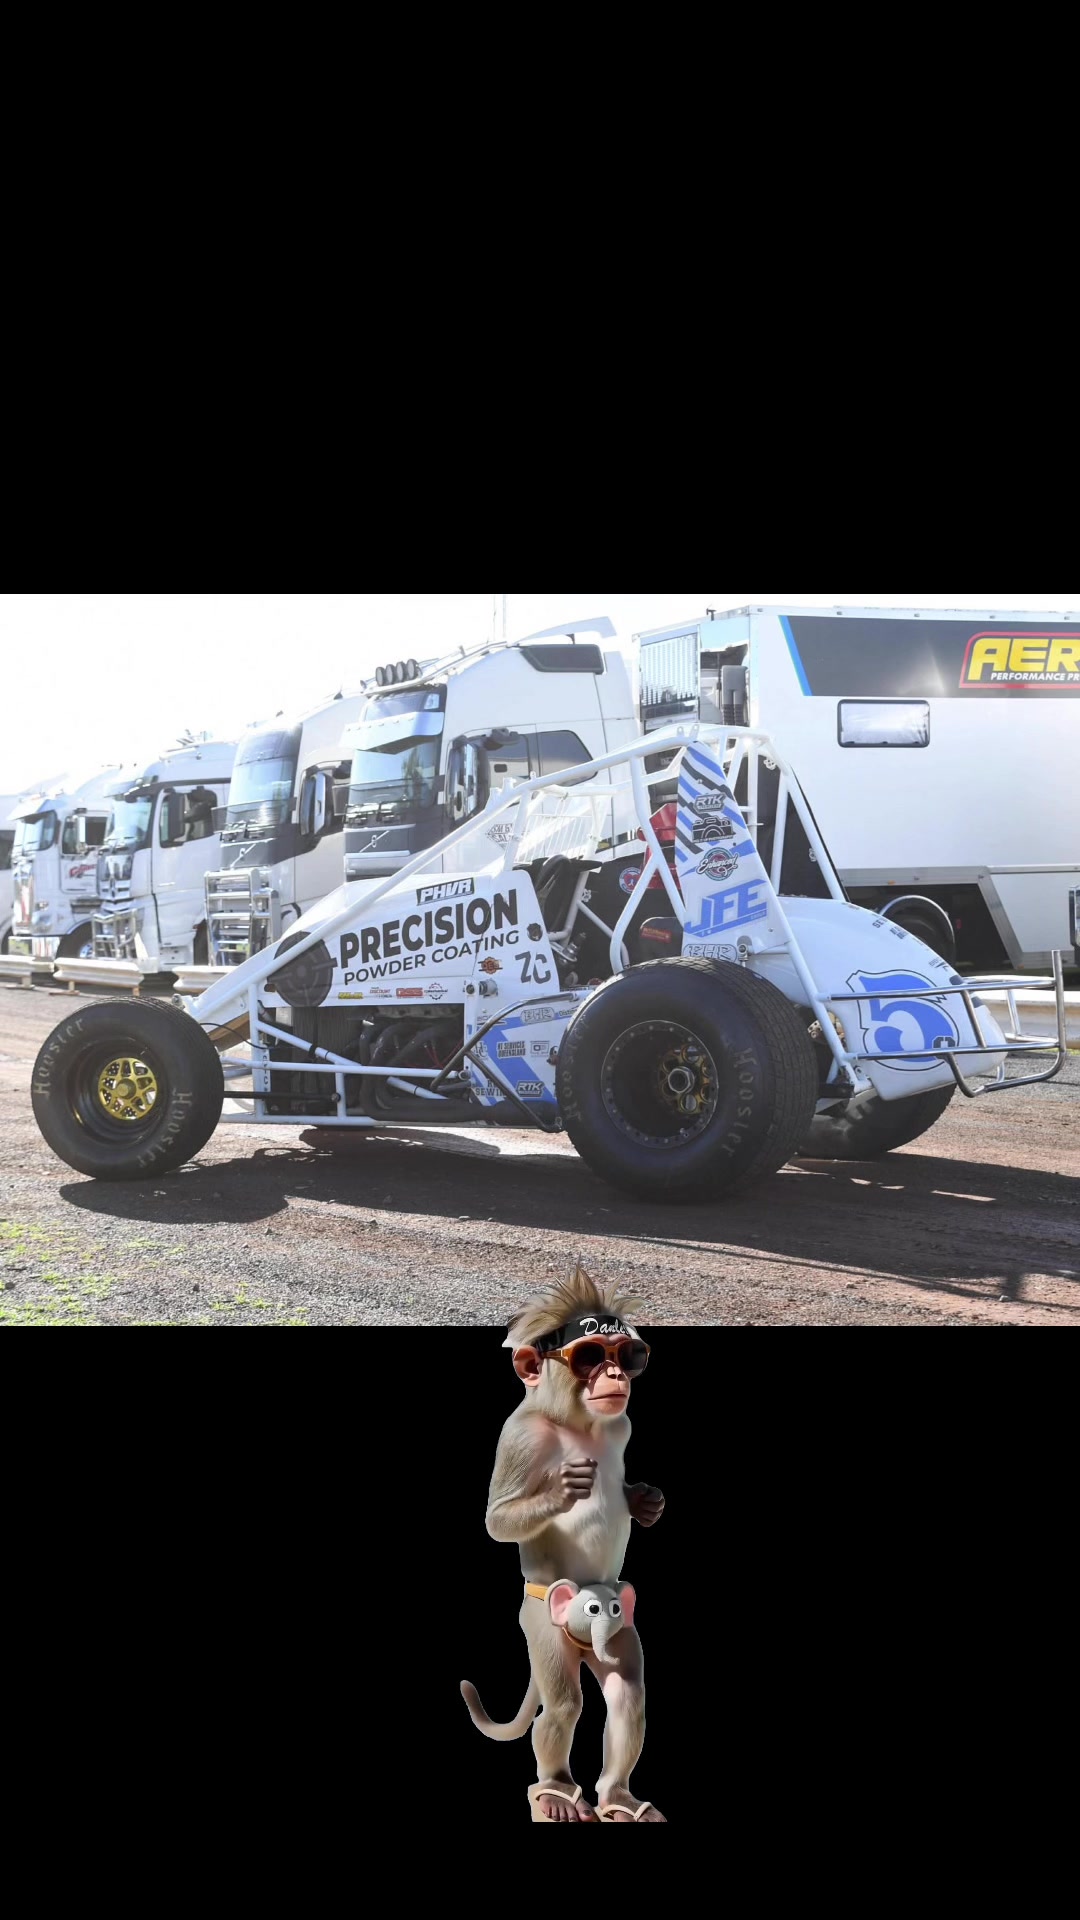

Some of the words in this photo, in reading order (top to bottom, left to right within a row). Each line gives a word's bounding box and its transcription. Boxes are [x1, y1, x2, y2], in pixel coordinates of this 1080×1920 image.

[990, 672, 1066, 681] PERFORMANCE
[696, 795, 723, 806] RTK
[339, 888, 518, 969] PRECISION
[683, 879, 767, 934] JFE
[344, 954, 426, 986] POWDER
[431, 929, 520, 964] COATING
[858, 973, 954, 1063] 5
[518, 1082, 543, 1091] RTK
